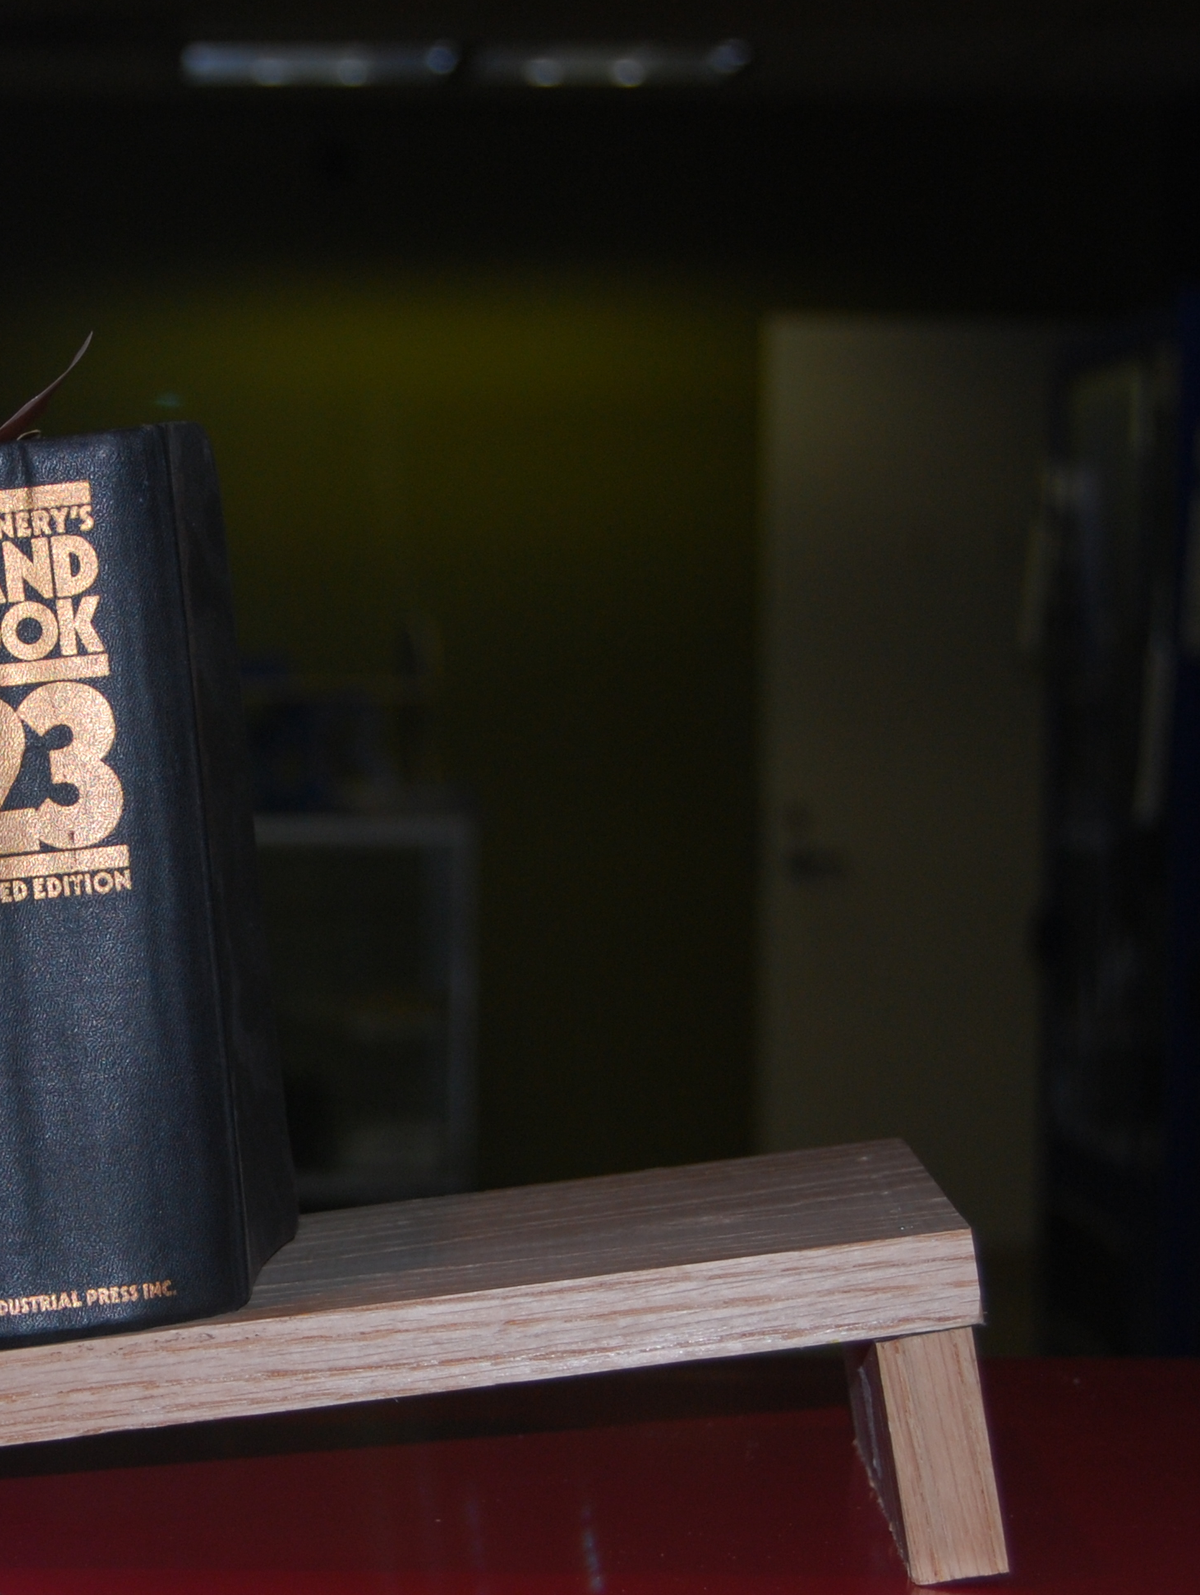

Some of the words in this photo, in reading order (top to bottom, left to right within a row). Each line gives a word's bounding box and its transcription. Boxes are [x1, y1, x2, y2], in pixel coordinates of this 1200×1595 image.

[33, 870, 132, 899] EDITION
[86, 1283, 139, 1306] PRESS
[142, 1280, 177, 1299] INC.
